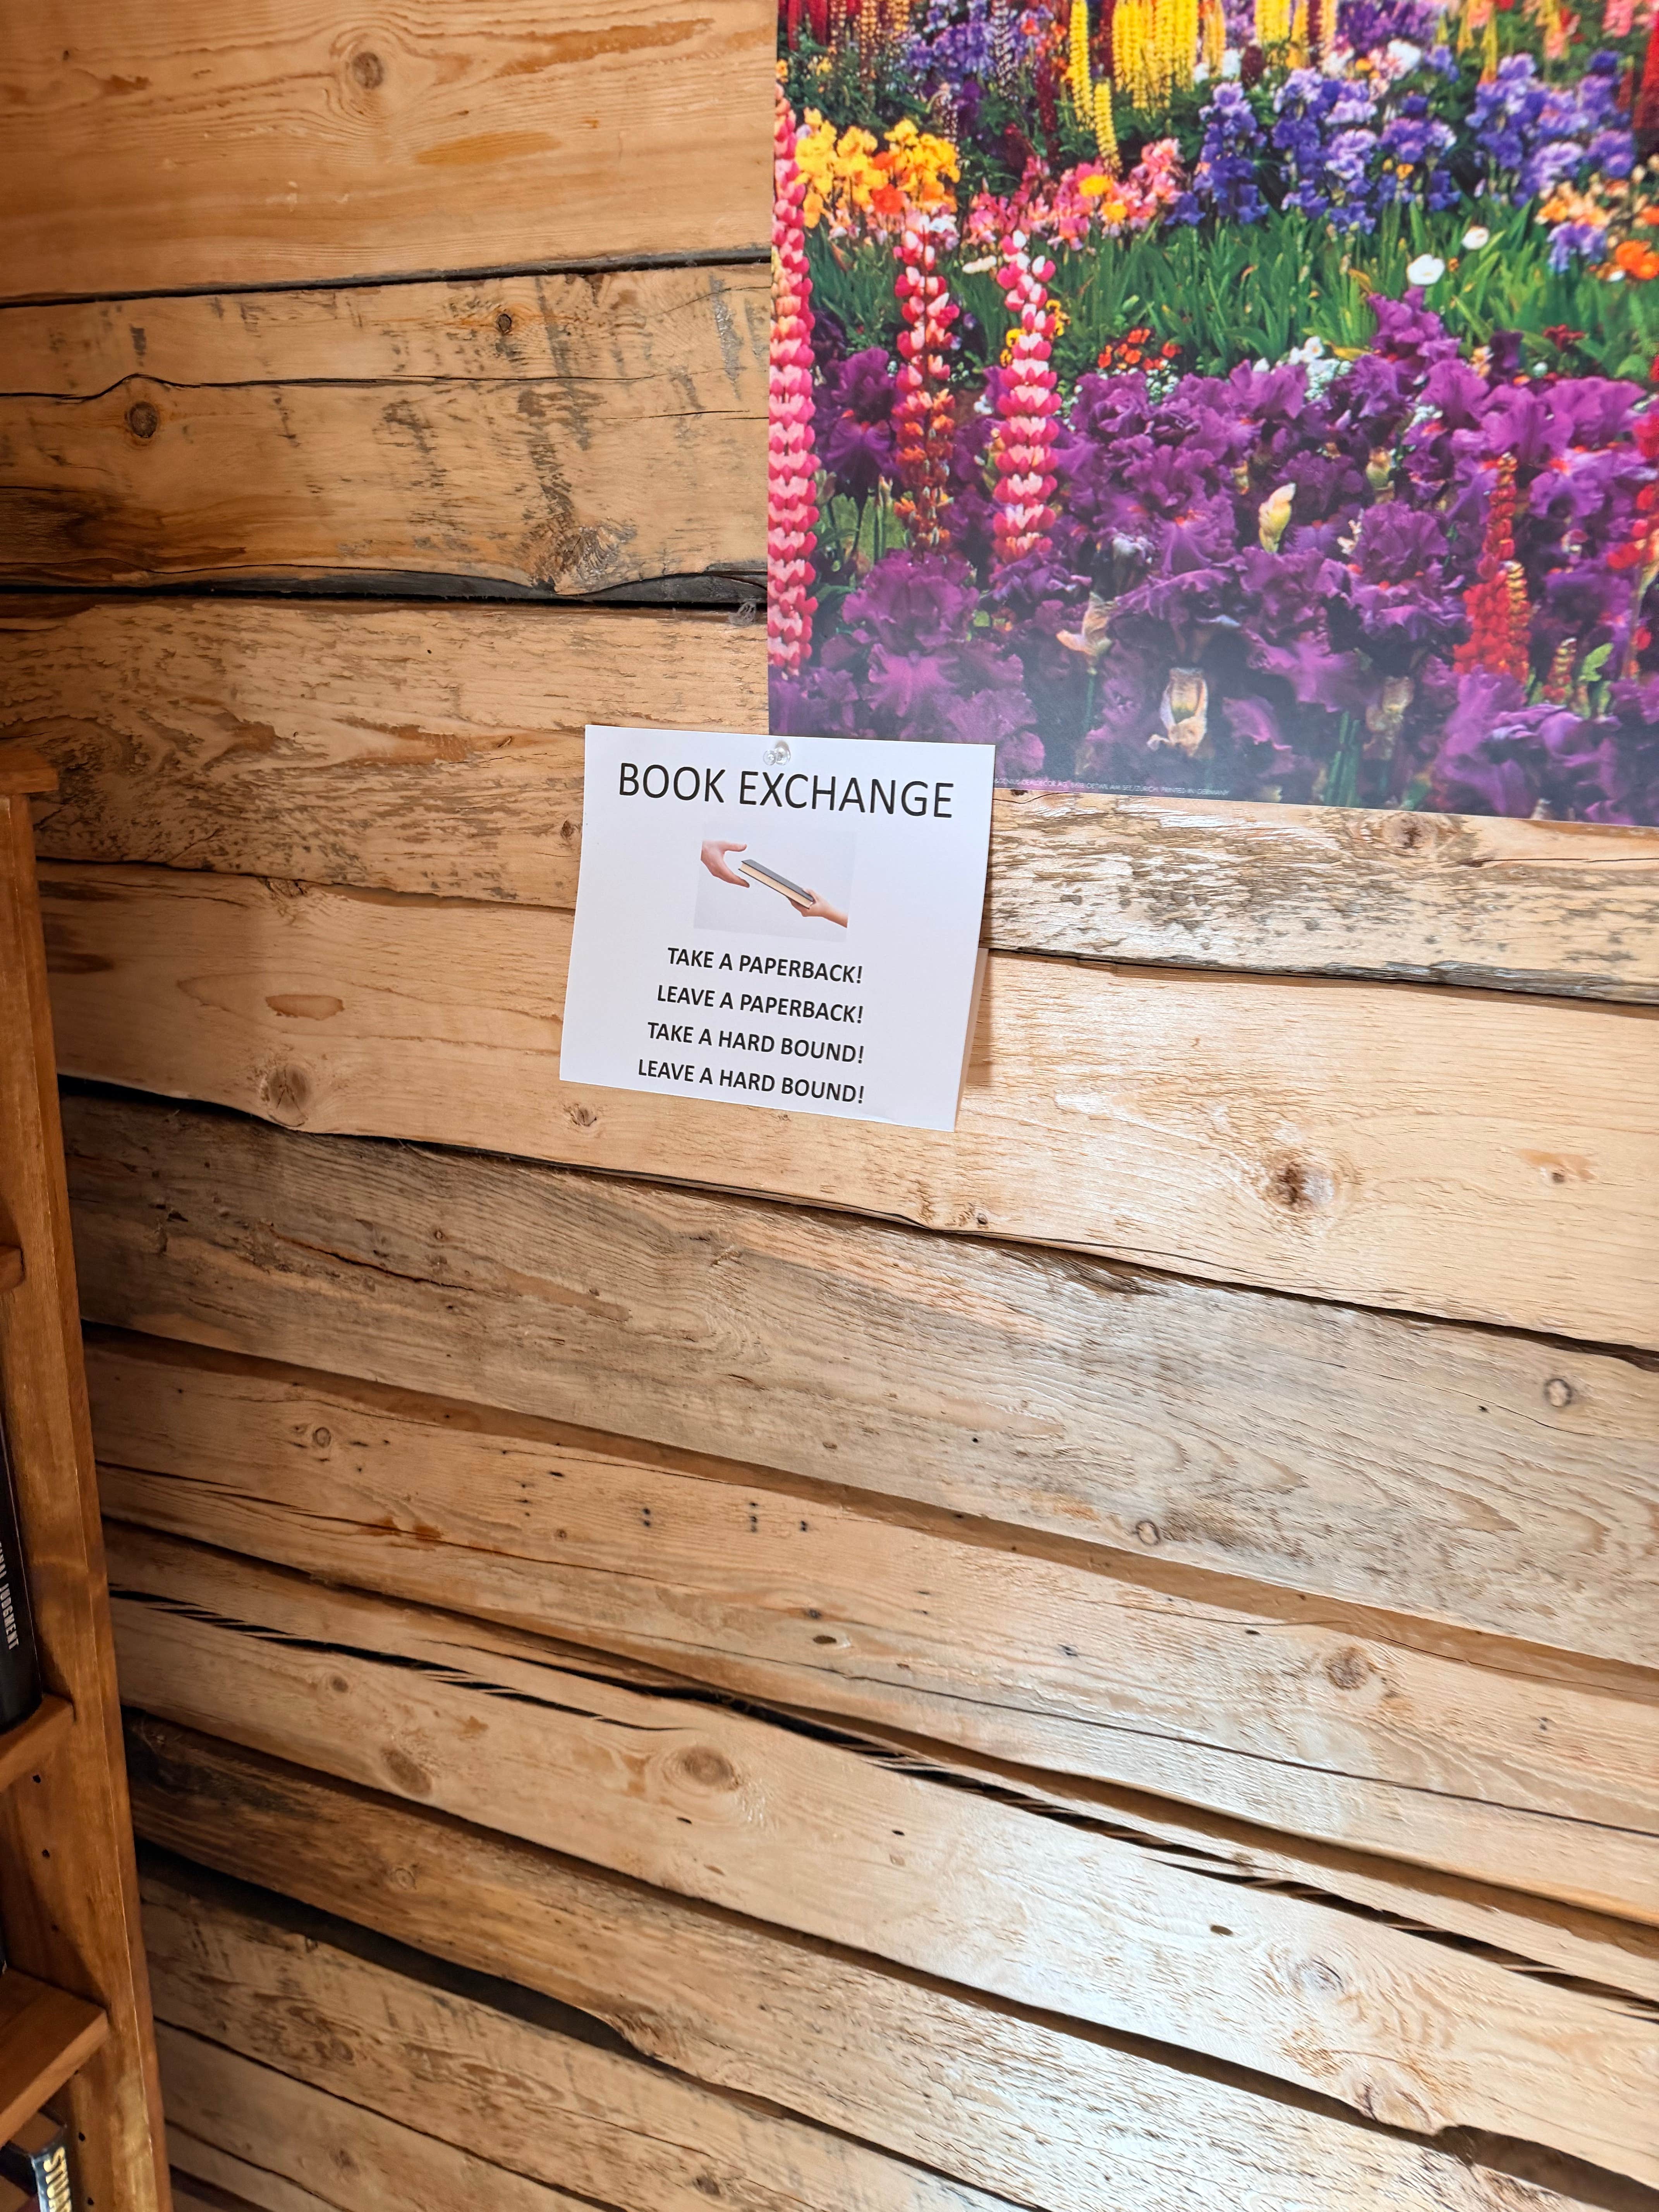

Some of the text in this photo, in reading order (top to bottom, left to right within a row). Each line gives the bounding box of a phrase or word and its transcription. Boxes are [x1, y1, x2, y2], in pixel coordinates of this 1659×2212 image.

[619, 762, 954, 818] BOOK EXCHANGE
[667, 947, 862, 984] TAKE A PAPERBACK!
[657, 984, 863, 1024] LEAVE A PAPERBACK!
[647, 1021, 864, 1064] TAKE A HARD BOUND!
[638, 1059, 864, 1104] LEAVE A HARD BOUND!
[0, 1583, 19, 1650] JUDGMENT
